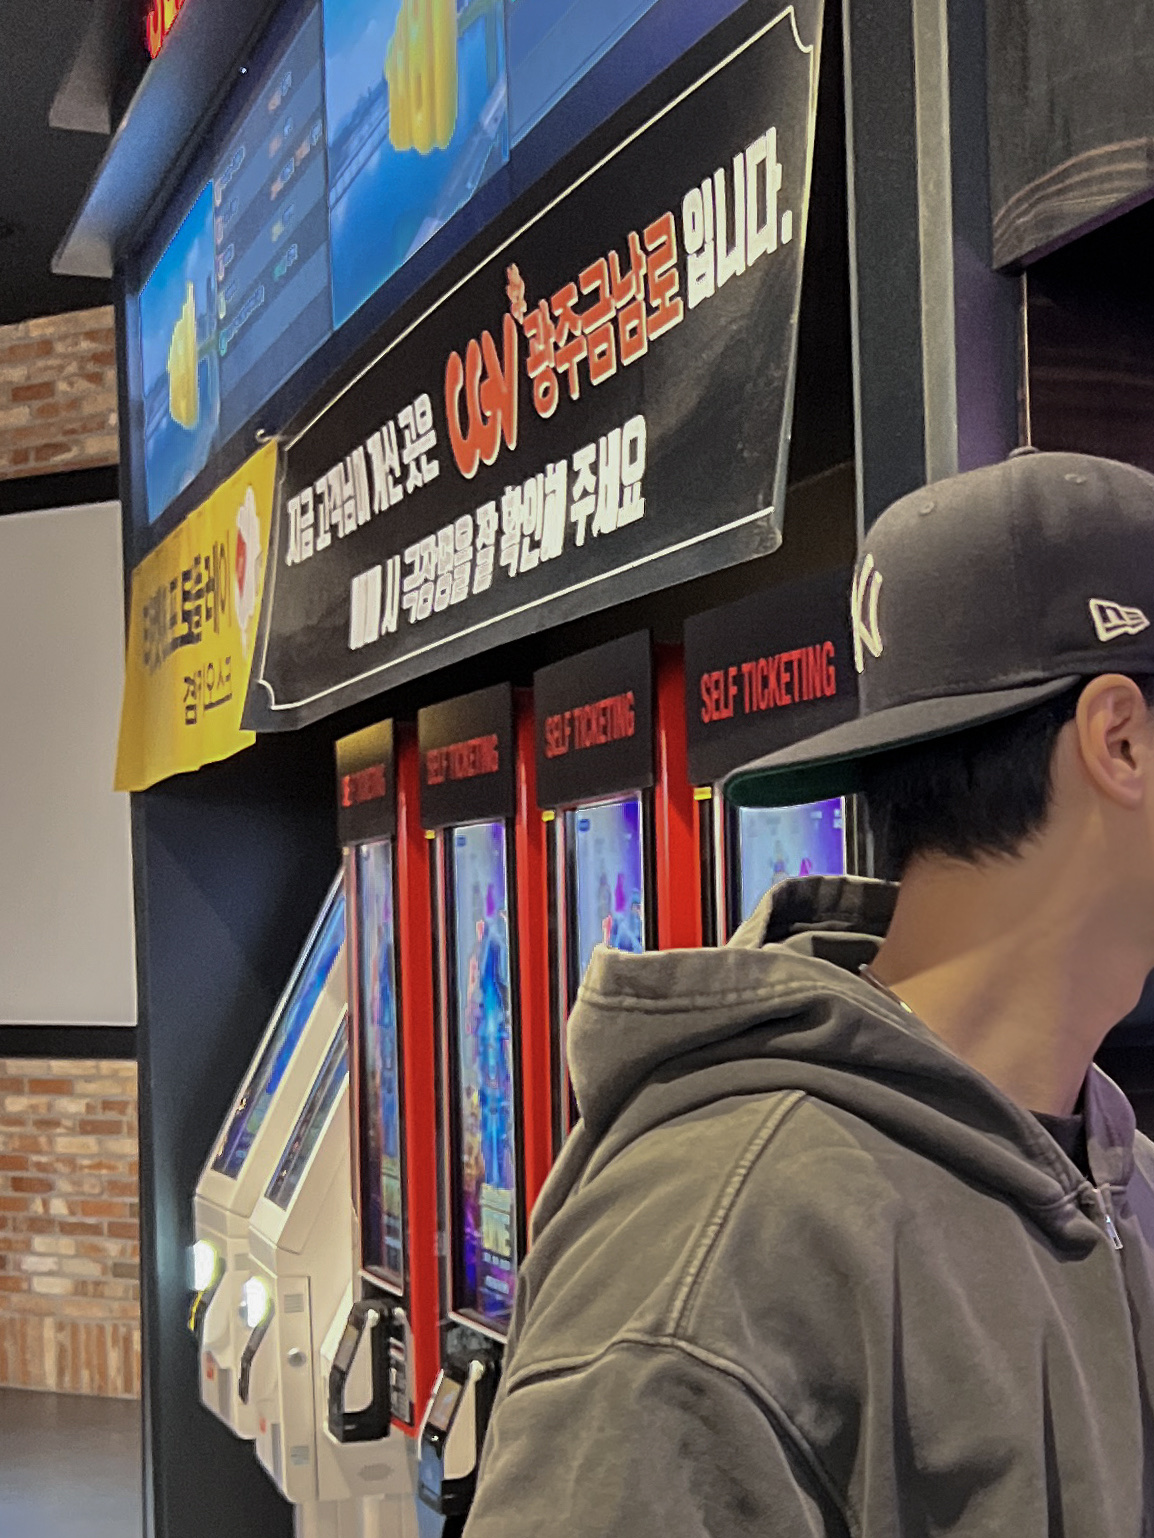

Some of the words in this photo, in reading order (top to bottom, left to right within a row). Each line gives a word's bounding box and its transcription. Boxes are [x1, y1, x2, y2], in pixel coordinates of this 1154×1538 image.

[397, 392, 440, 495] 곳은
[445, 311, 519, 480] CGV
[569, 413, 648, 548] 주세요
[545, 711, 572, 760] SELF
[572, 689, 636, 751] TICKETING
[701, 666, 738, 723] SELF
[740, 640, 837, 715] TICKETING
